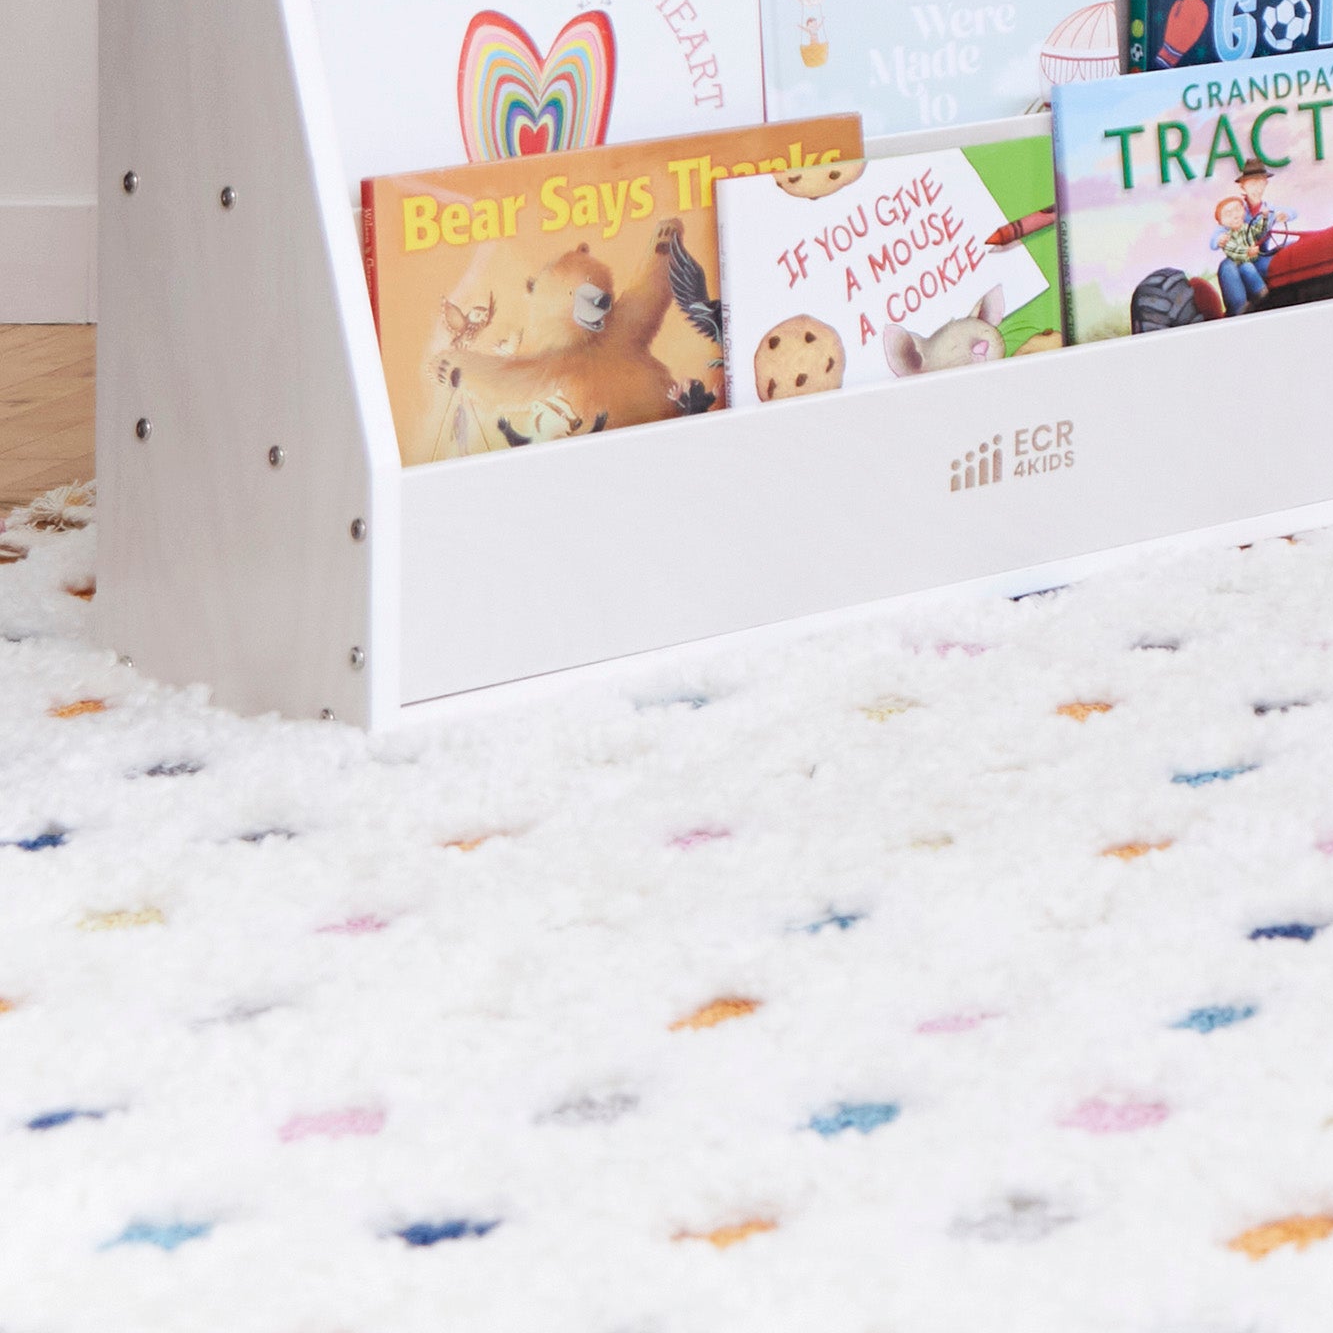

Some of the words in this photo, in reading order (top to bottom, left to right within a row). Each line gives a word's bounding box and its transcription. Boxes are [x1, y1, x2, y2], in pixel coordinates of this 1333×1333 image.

[911, 1, 1017, 40] Were
[869, 40, 982, 99] Made
[402, 193, 526, 253] Bear
[540, 175, 654, 239] Says
[778, 240, 810, 289] IF
[814, 204, 869, 262] YOU
[874, 167, 944, 228] GIVE
[844, 266, 862, 303] A
[867, 205, 964, 283] MOUSE
[859, 312, 877, 346] A
[886, 235, 986, 324] COOKIE
[1012, 449, 1076, 478] 4KIDS
[1014, 419, 1075, 457] ECR
